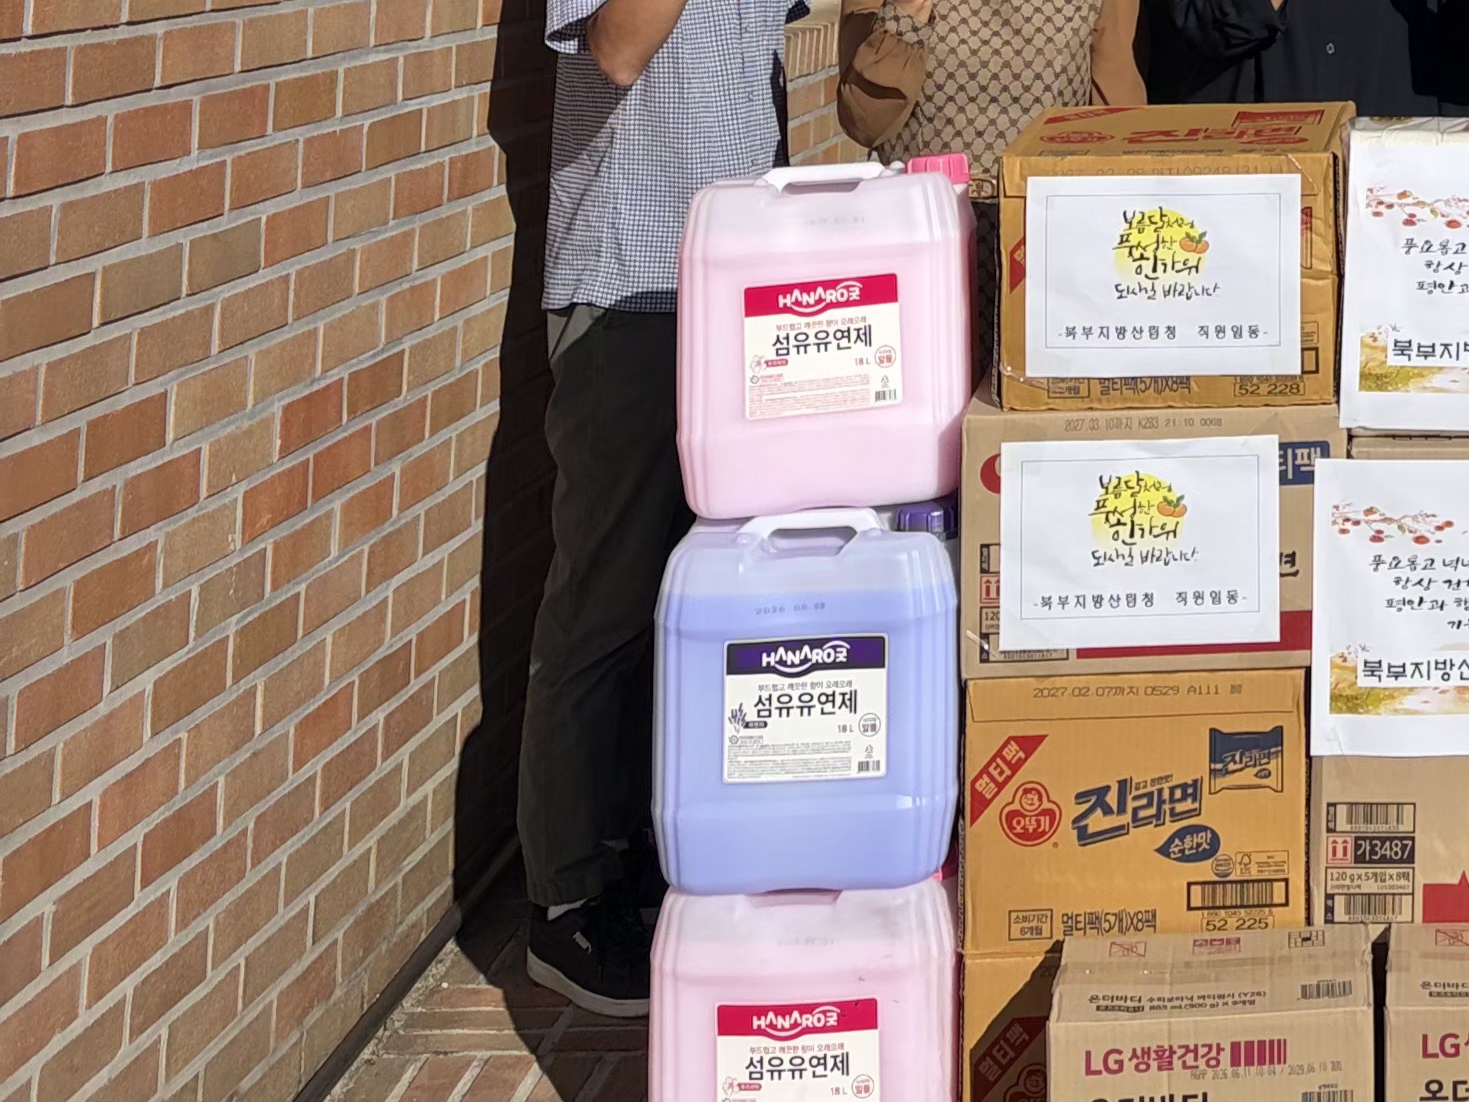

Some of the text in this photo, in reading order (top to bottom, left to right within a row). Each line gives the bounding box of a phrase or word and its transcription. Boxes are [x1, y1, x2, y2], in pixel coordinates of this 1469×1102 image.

[1122, 207, 1195, 233] 보름달처럼
[1112, 232, 1177, 258] 풍성한
[1401, 238, 1468, 257] 풍요롭고
[1132, 252, 1202, 280] 한가위
[1424, 259, 1467, 275] 항상
[1162, 282, 1222, 300] 바랍니다
[772, 324, 872, 357] 섬유유연제
[1238, 382, 1301, 395] 52 228
[1099, 471, 1173, 497] 보름달처럼
[1088, 497, 1155, 524] 풍성한
[1109, 517, 1180, 546] 한가위
[1139, 546, 1199, 566] 바랍니다
[1369, 555, 1435, 574] 풍요롭고
[1393, 575, 1438, 590] 항상
[1384, 596, 1448, 612] 평안과
[1144, 685, 1180, 696] 0529
[753, 689, 858, 719] 섬유유연제
[974, 740, 1026, 800] 멀티팩
[1071, 776, 1203, 847] 진라면
[1012, 815, 1050, 834] 오뚜기
[1169, 829, 1212, 860] 순한맛
[1357, 839, 1412, 861] 가3487
[1013, 913, 1048, 924] 소비기간
[1206, 918, 1269, 931] 52 225
[978, 1022, 1029, 1081] 멀티팩
[745, 1052, 850, 1081] 섬유유연제
